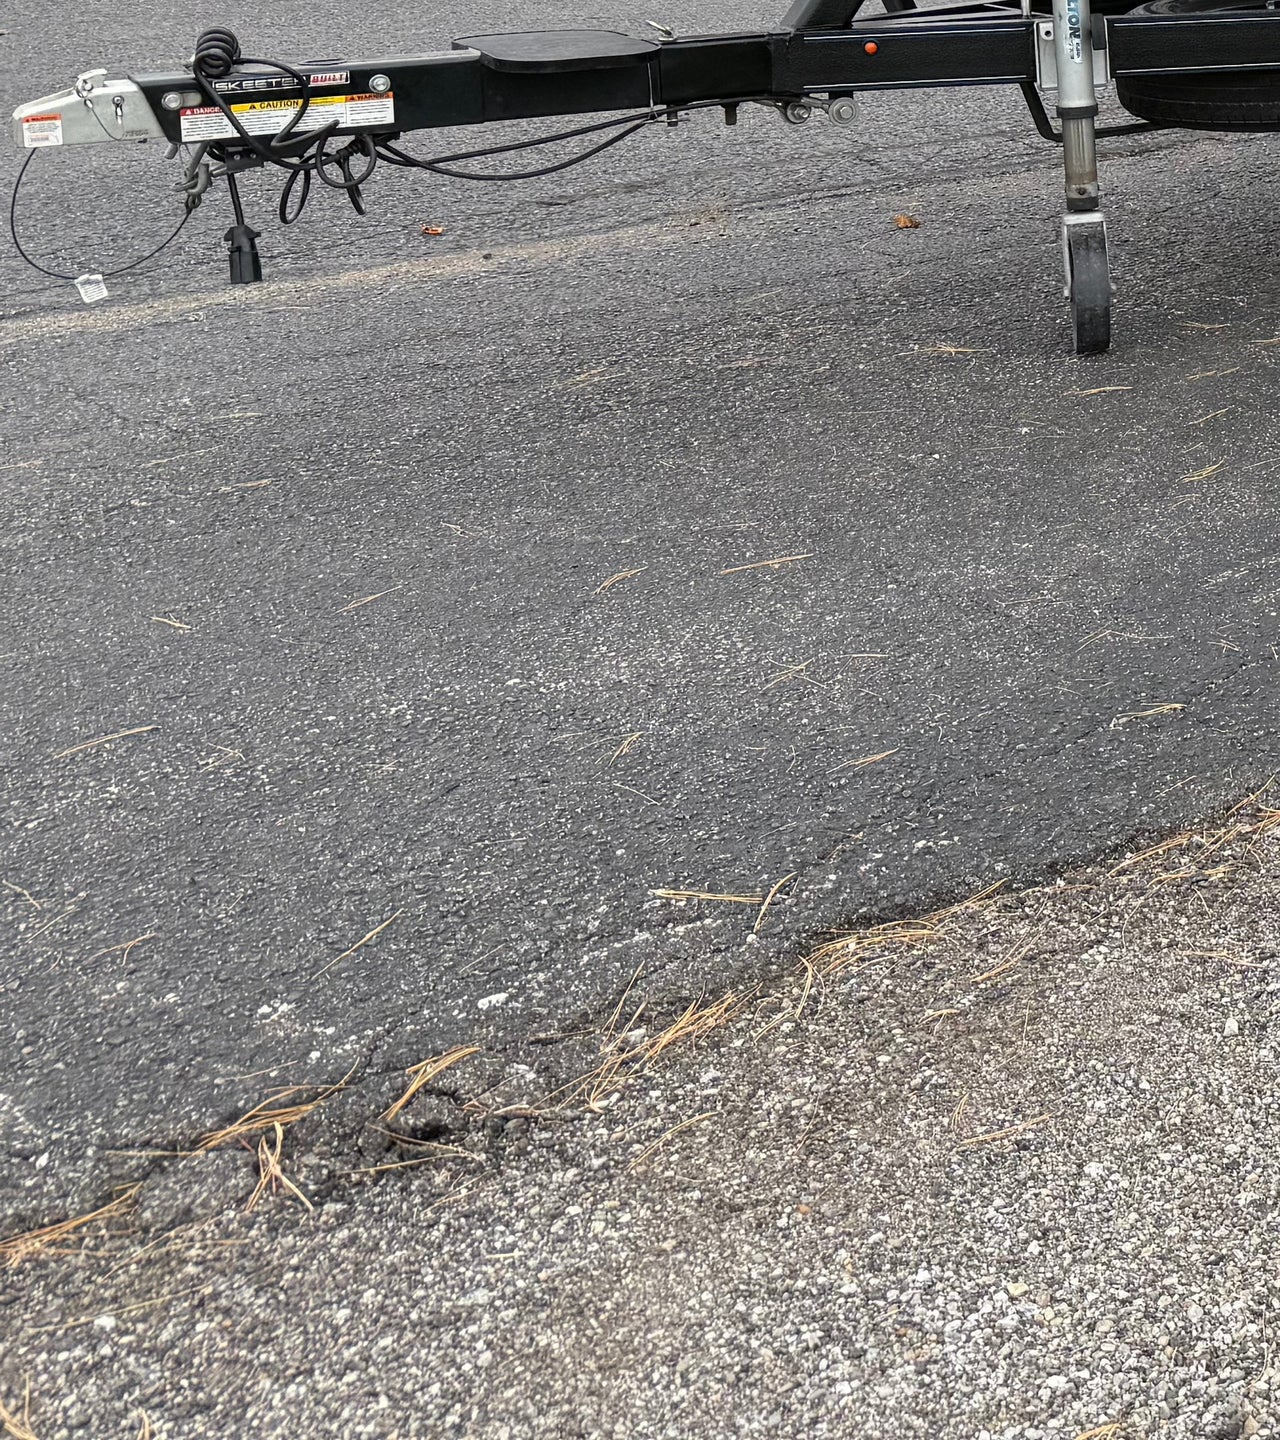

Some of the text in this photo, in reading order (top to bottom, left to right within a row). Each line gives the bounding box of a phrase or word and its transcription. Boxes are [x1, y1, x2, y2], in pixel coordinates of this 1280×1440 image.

[311, 73, 346, 84] BUILT
[259, 99, 299, 111] CAUTION
[193, 107, 223, 115] DANGE
